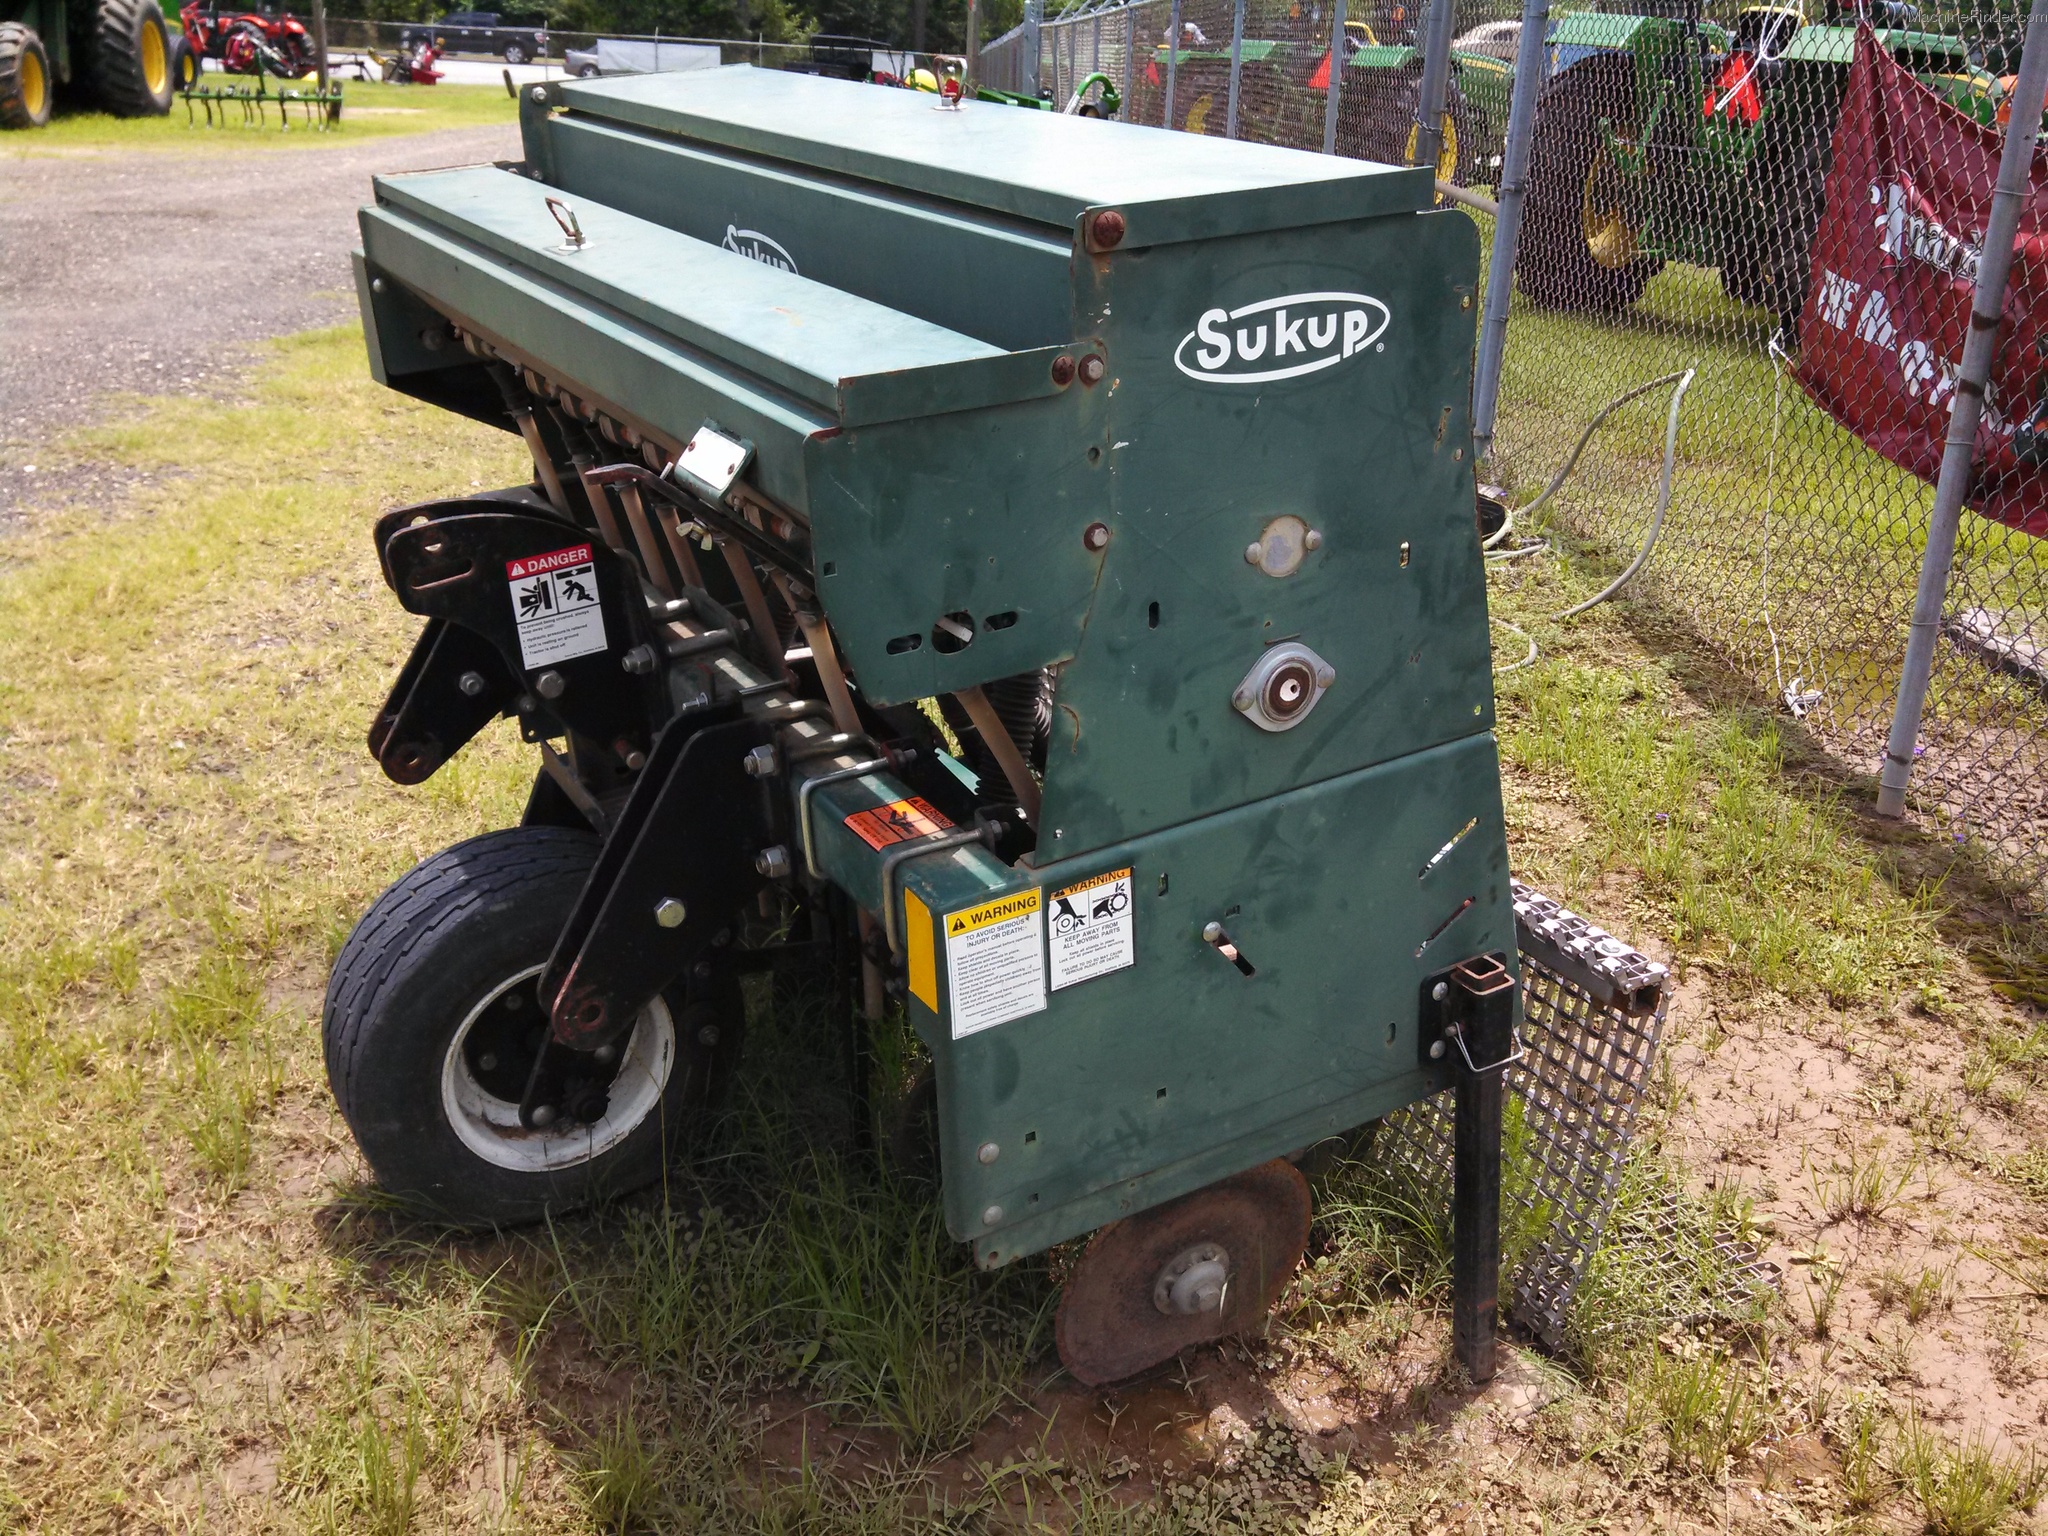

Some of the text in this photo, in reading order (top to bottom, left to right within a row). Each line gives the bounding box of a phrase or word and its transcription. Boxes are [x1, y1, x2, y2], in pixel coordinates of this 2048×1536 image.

[1817, 268, 1861, 331] THE
[1196, 308, 1368, 370] Sukup
[527, 548, 588, 573] DANGER
[918, 800, 953, 829] WARNING
[1069, 871, 1125, 893] WARNING
[970, 896, 1037, 924] WARNING
[966, 919, 1025, 942] TO AVOID SERIOUS
[967, 937, 989, 949] INJURY
[991, 933, 1000, 941] OR
[1063, 926, 1120, 950] ALL MOVING PARTS
[1065, 921, 1118, 944] KEEP AWAY FROM
[1062, 965, 1078, 973] FAILURE
[1066, 967, 1083, 976] SERIOUS
[1084, 962, 1098, 970] INJURY
